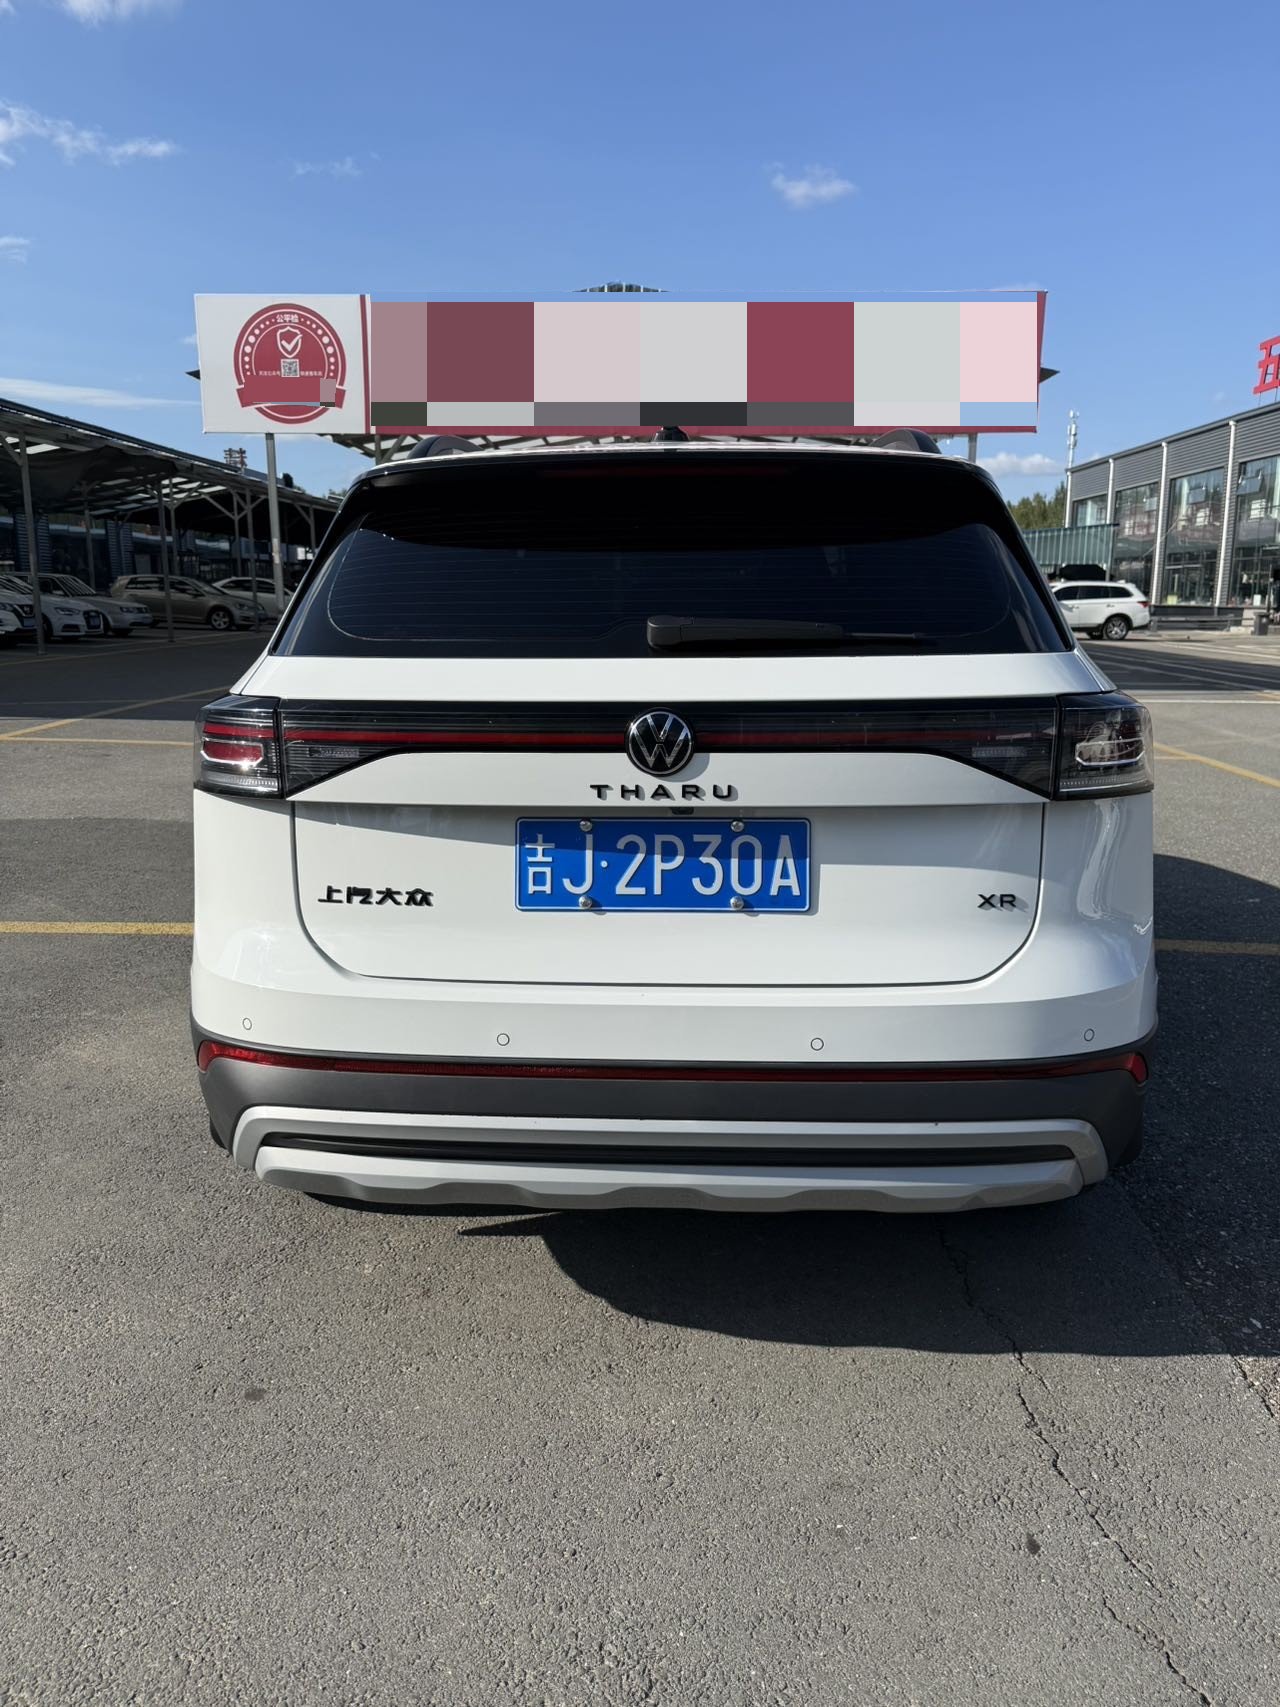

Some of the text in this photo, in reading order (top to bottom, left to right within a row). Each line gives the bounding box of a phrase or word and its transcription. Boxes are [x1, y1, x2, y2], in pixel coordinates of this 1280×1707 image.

[589, 784, 733, 799] THARU
[317, 885, 434, 907] 上汽大众
[977, 893, 1017, 909] XR
